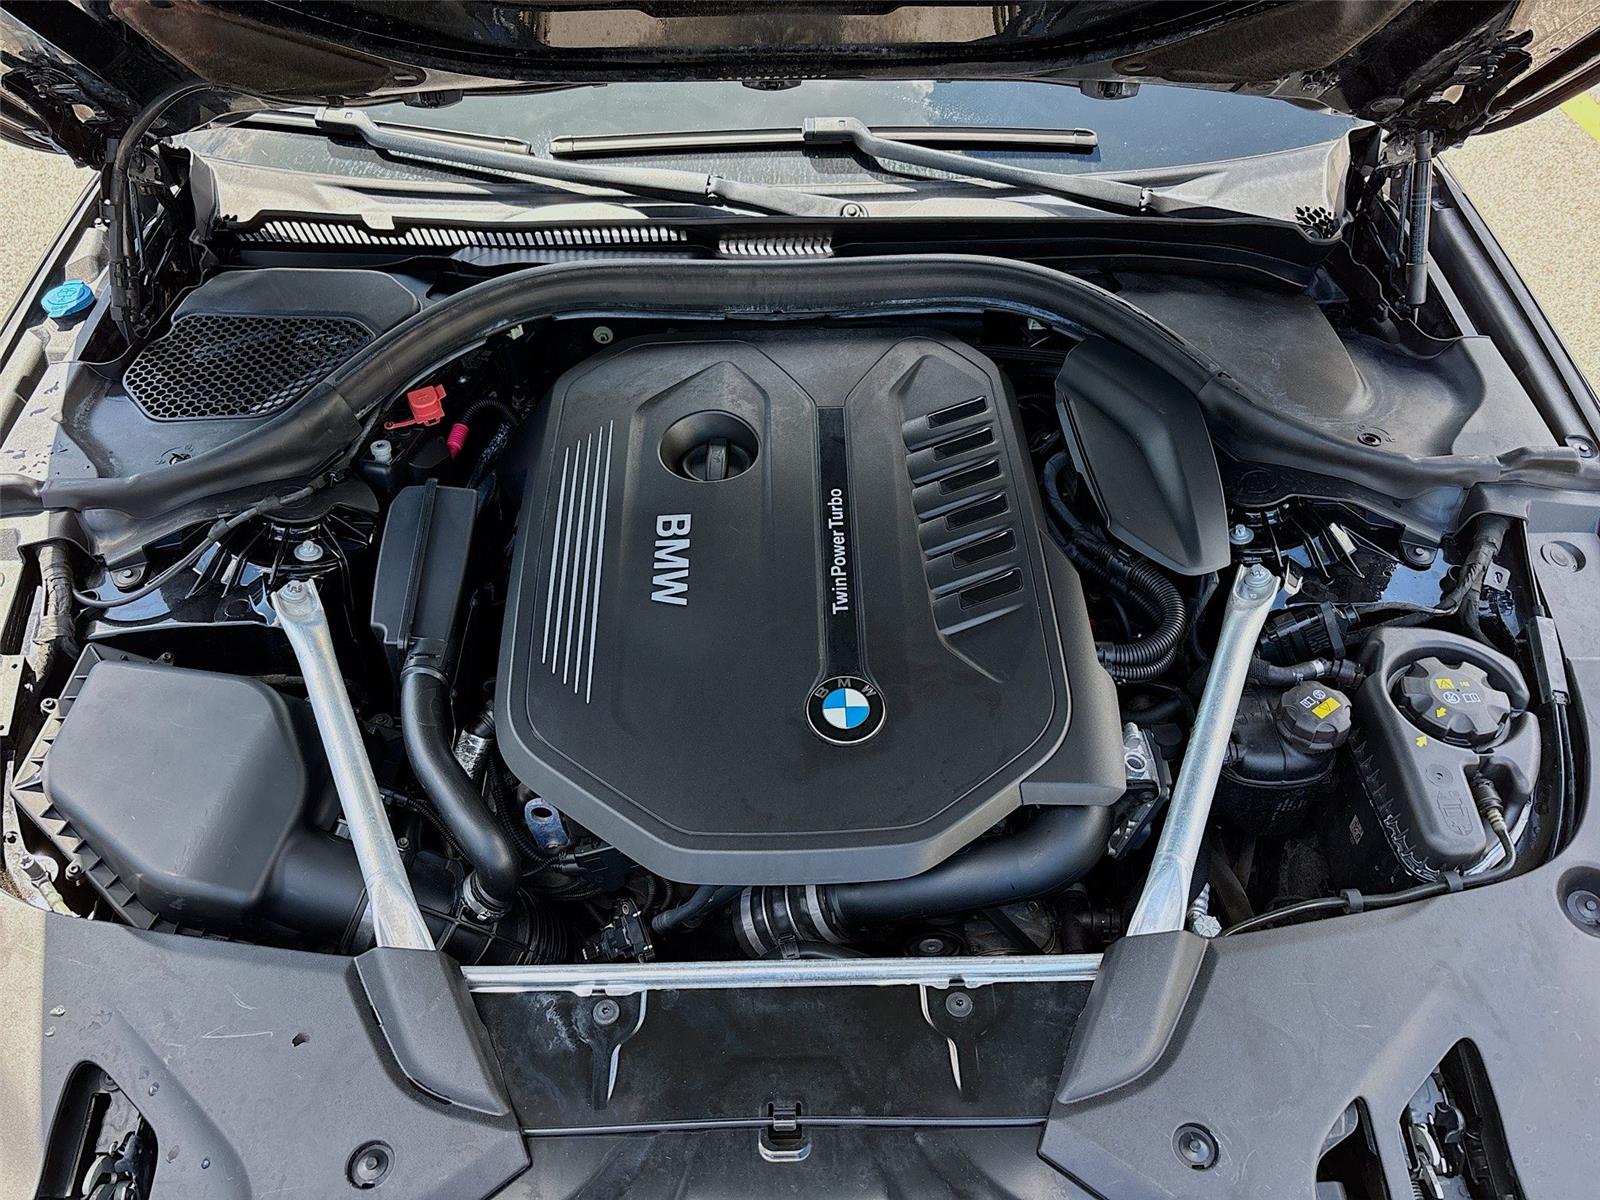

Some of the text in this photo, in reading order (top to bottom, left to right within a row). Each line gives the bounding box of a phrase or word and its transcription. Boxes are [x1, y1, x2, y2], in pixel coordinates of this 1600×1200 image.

[827, 488, 844, 529] Turbo
[651, 513, 692, 606] BMW
[814, 678, 877, 699] BMW
